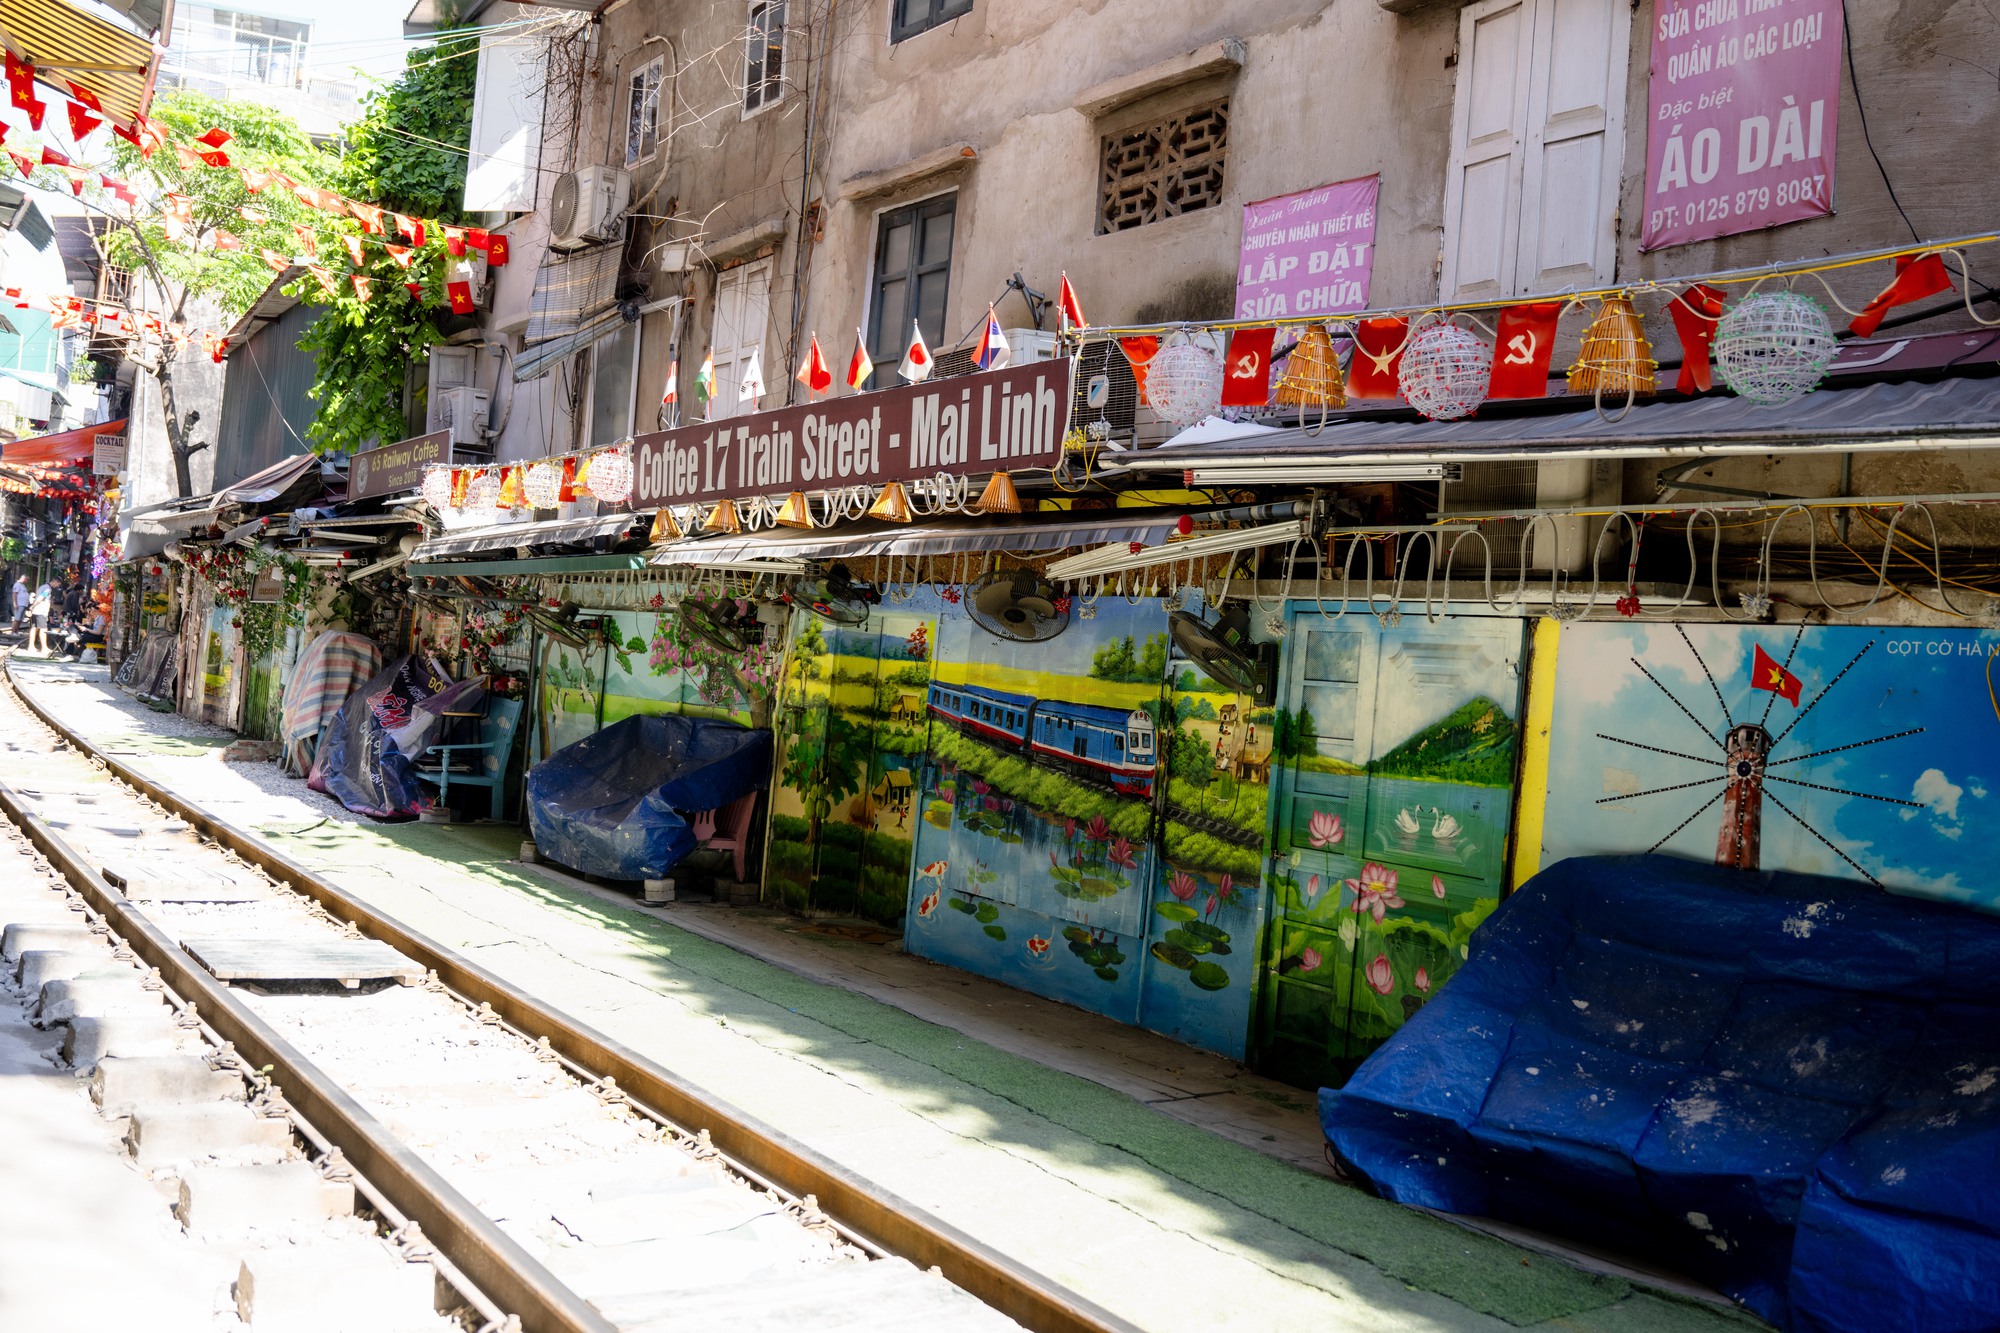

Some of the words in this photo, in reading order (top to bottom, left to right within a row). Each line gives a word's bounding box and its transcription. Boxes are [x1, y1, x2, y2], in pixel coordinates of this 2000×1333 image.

[1667, 39, 1712, 84] QUẦN
[1715, 35, 1739, 69] ÁO
[1743, 24, 1778, 61] CÁC
[1782, 12, 1823, 50] LOẠI
[1658, 99, 1693, 120] Đặc
[1697, 86, 1734, 111] biệt
[1656, 123, 1721, 194] ÁO
[1737, 94, 1824, 175] DÀI
[1650, 206, 1679, 233] ĐT:
[1685, 195, 1730, 226] 0125
[1734, 186, 1770, 215] 879
[1776, 174, 1825, 207] 8087
[1245, 228, 1286, 251] CHUYÊN
[1288, 222, 1319, 243] NHẬN
[1322, 211, 1353, 236] THIẾT
[1243, 252, 1298, 287] LẮP
[1308, 242, 1370, 275] ĐẶT
[1241, 287, 1288, 319] SỬA
[1295, 278, 1363, 312] CHỮA
[95, 436, 124, 447] COCKTAIL
[371, 454, 382, 472] 65
[382, 449, 412, 470] Railway
[413, 440, 439, 462] Coffee
[639, 439, 699, 500] Coffee
[702, 426, 733, 493] 17
[737, 421, 793, 488] Train
[800, 406, 881, 482] Street
[909, 388, 971, 469] Mai
[980, 375, 1056, 461] Linh
[388, 474, 403, 488] Since
[404, 470, 418, 484] 2018
[1886, 640, 1923, 657] CỘT
[1926, 639, 1954, 656] CỜ
[1958, 640, 1983, 656] HÀ
